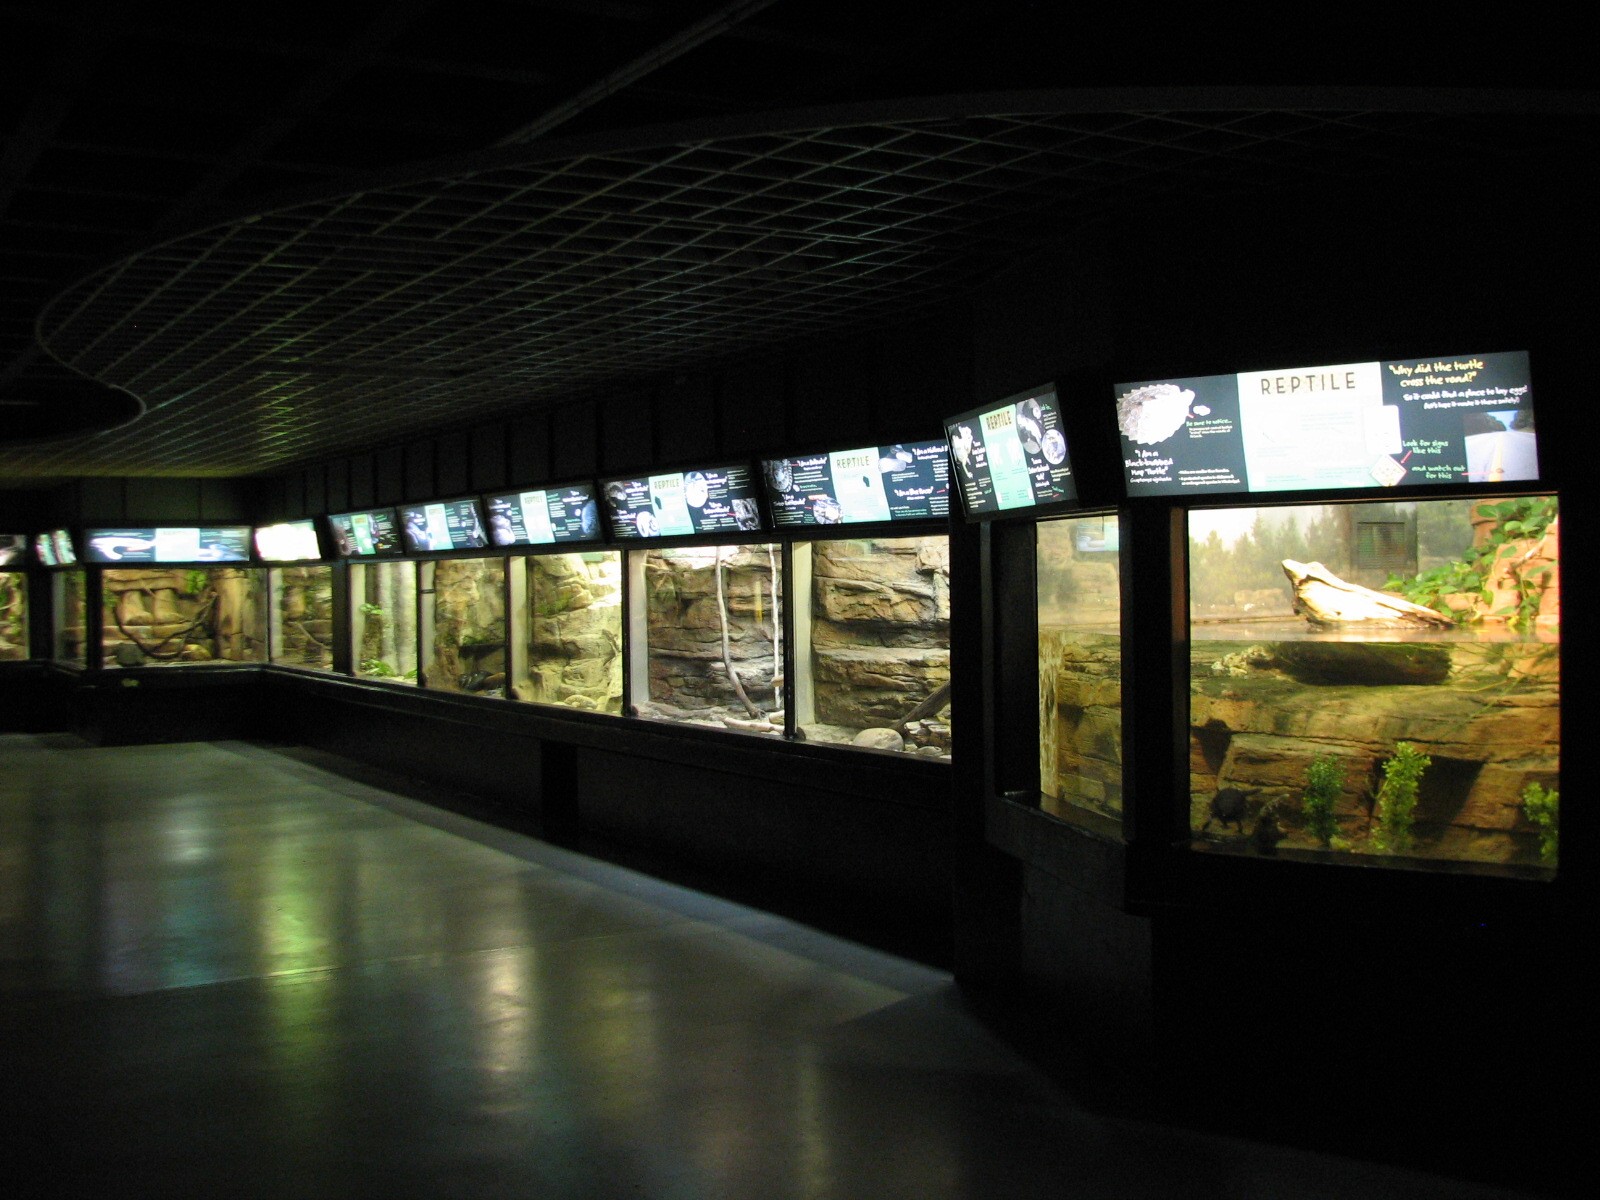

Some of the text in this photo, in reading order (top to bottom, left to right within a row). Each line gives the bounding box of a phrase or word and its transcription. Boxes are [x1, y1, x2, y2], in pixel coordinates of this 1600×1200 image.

[1414, 363, 1432, 373] did
[1433, 362, 1452, 373] the
[1454, 358, 1484, 371] turtle
[1260, 372, 1356, 395] REPTILE
[1400, 377, 1424, 388] cross
[1425, 374, 1444, 385] the
[986, 410, 1012, 430] REPTILE
[1402, 439, 1448, 448] Look for signs
[1427, 446, 1441, 454] this
[837, 455, 870, 469] REPTILE
[1427, 464, 1452, 472] watch
[654, 478, 680, 490] REPTILE
